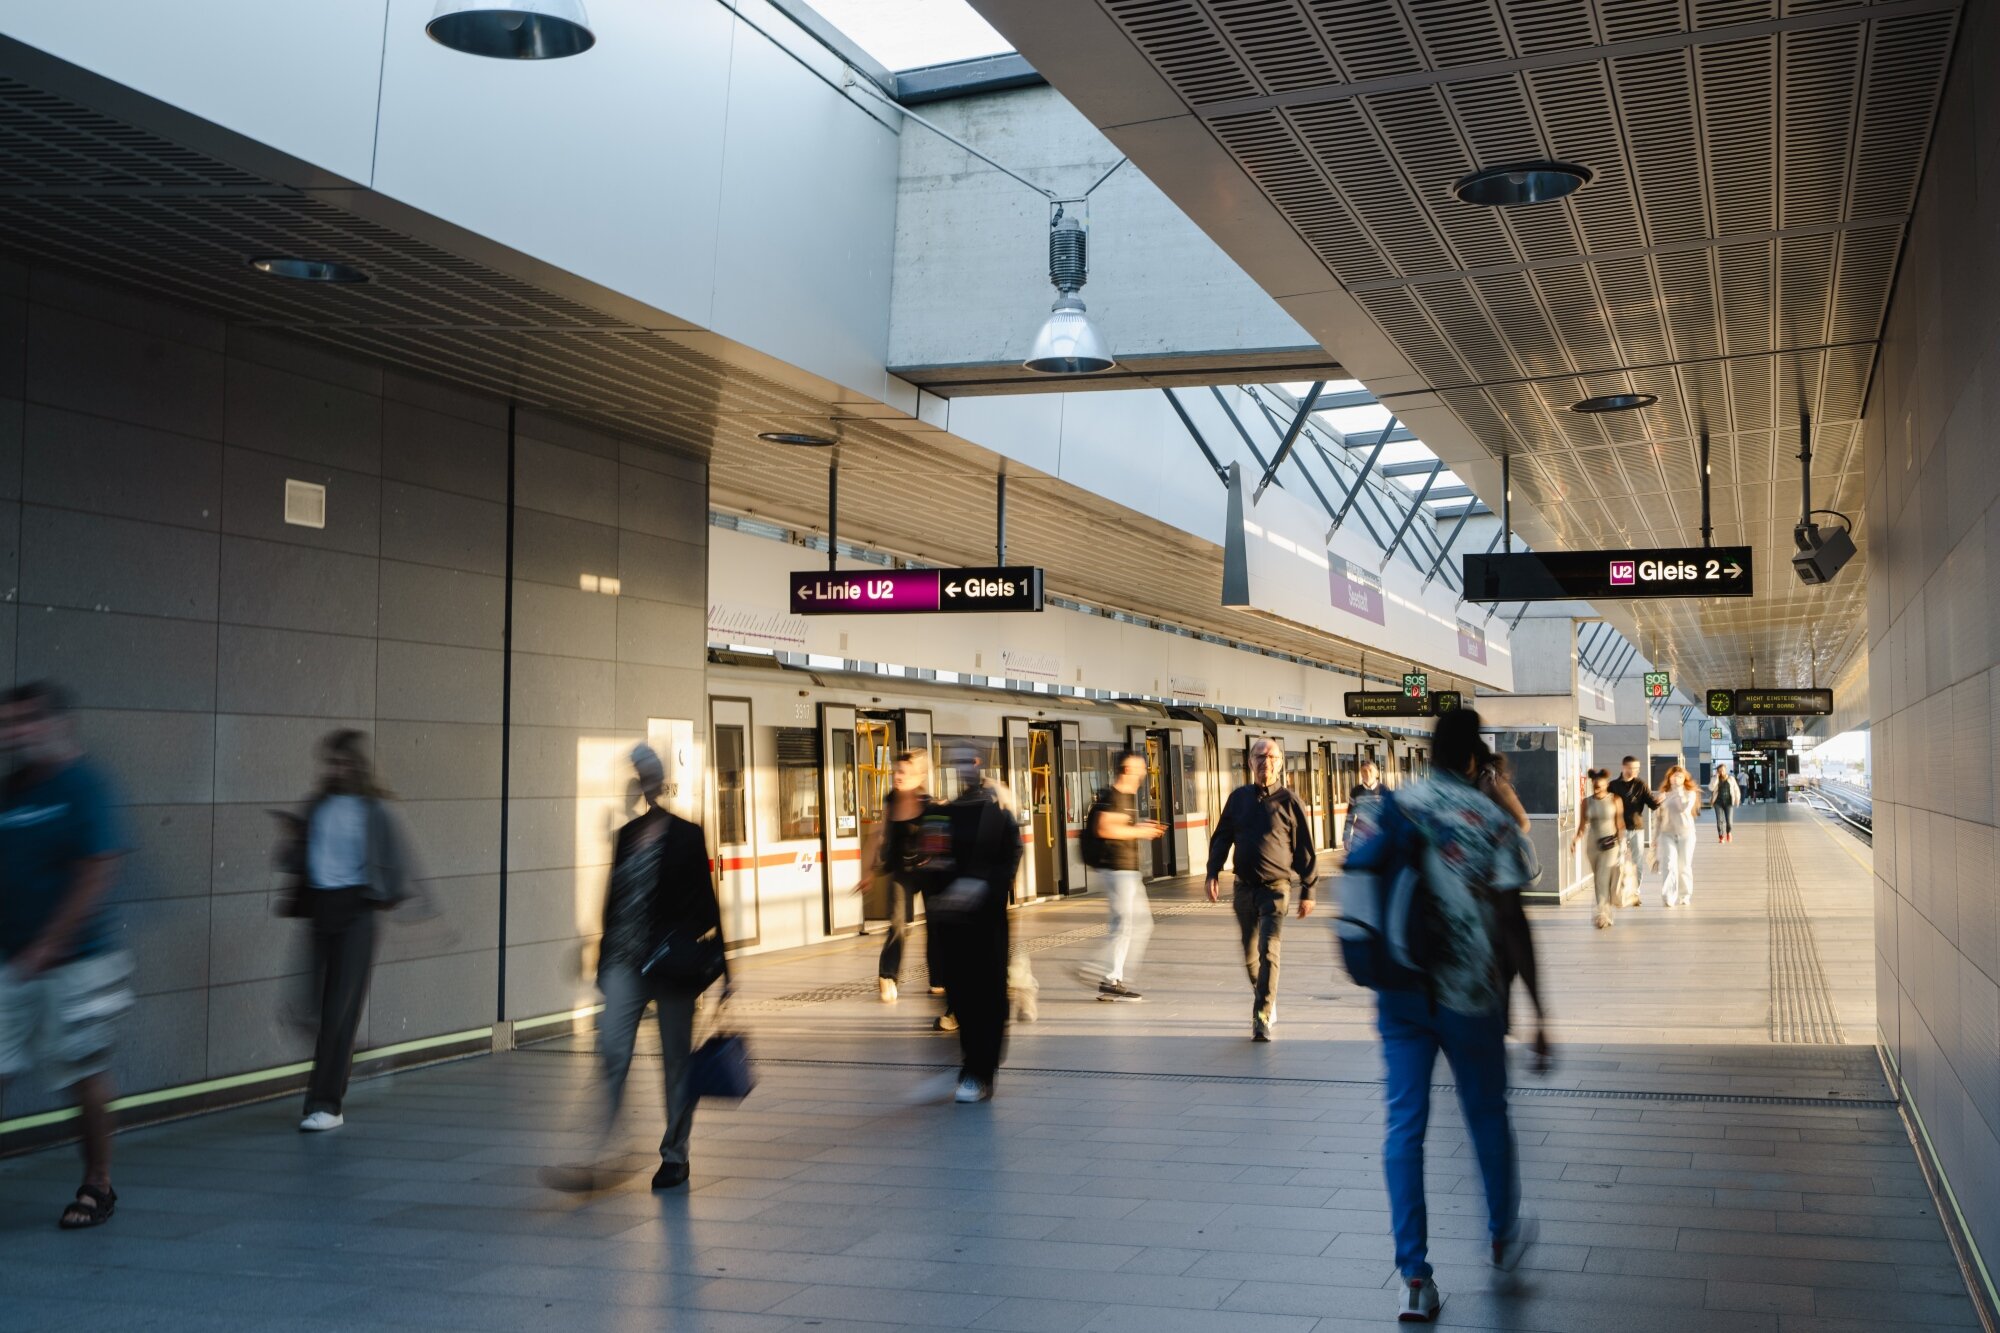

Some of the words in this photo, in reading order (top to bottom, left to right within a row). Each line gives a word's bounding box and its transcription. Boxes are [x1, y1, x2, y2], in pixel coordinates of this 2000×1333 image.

[1612, 565, 1632, 578] U2
[1639, 560, 1697, 580] Gleis
[1705, 560, 1719, 579] 2
[816, 581, 861, 599] Linie
[867, 580, 893, 599] U2
[964, 578, 1014, 597] Gleis
[1020, 578, 1027, 596] 1
[1405, 675, 1425, 685] SOS
[1646, 674, 1667, 684] SOS
